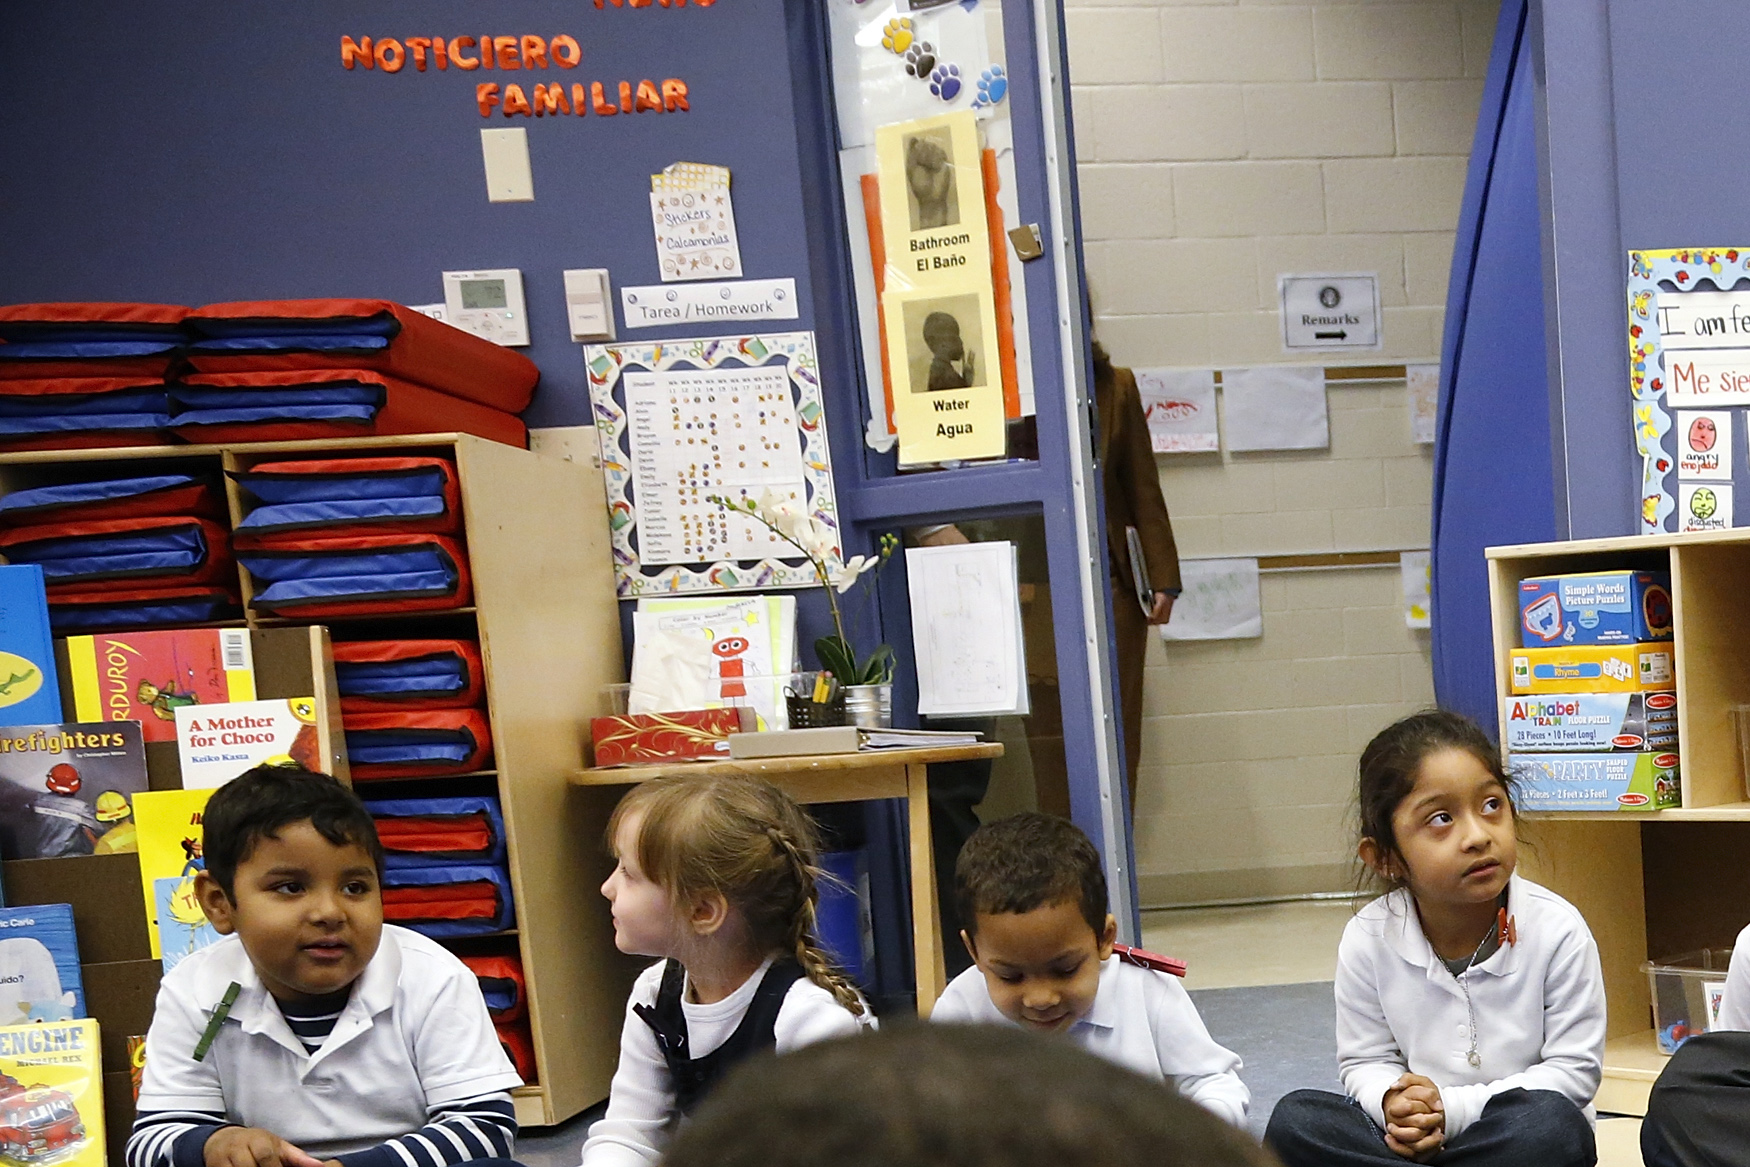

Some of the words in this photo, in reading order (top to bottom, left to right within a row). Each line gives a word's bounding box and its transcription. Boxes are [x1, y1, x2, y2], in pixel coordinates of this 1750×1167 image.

[341, 34, 582, 73] NOTICIERO
[476, 77, 690, 117] FAMILIAR
[664, 210, 711, 227] Stickers
[909, 233, 970, 252] Bathroom
[916, 257, 930, 272] El
[933, 253, 966, 269] Baño
[639, 306, 681, 320] Tarea
[695, 300, 774, 317] Homework
[1301, 313, 1360, 326] Remarks
[1658, 305, 1686, 336] I
[1694, 316, 1726, 336] am
[1673, 361, 1710, 394] Me
[933, 398, 970, 412] Water
[936, 422, 973, 438] Agua
[1681, 461, 1719, 474] enojado
[1686, 454, 1719, 466] angry
[1688, 517, 1725, 530] disgusted
[1564, 585, 1595, 596] Simple
[1597, 583, 1625, 594] Words
[1565, 595, 1594, 606] Picture
[1596, 594, 1625, 605] Puzzles
[1554, 667, 1580, 679] Rhyme
[1511, 700, 1580, 721] Alphabet
[189, 720, 202, 732] A
[207, 716, 275, 732] Mother
[1533, 716, 1562, 727] TRAIN
[1568, 716, 1587, 725] FLOOR
[1588, 715, 1611, 724] PUZZLE
[190, 734, 216, 748] for
[221, 730, 275, 745] Choco
[1517, 730, 1525, 740] 28
[1526, 730, 1546, 740] Pieces
[1553, 730, 1561, 739] 10
[1563, 729, 1577, 739] Feet
[1578, 729, 1596, 741] Long!
[191, 755, 220, 763] Keiko
[222, 753, 249, 762] Kasza
[1552, 760, 1606, 781] PARTY
[1606, 773, 1627, 781] PUZZLE
[0, 974, 24, 984] uido?
[0, 1026, 84, 1057] ENGINE
[62, 1055, 82, 1063] REX
